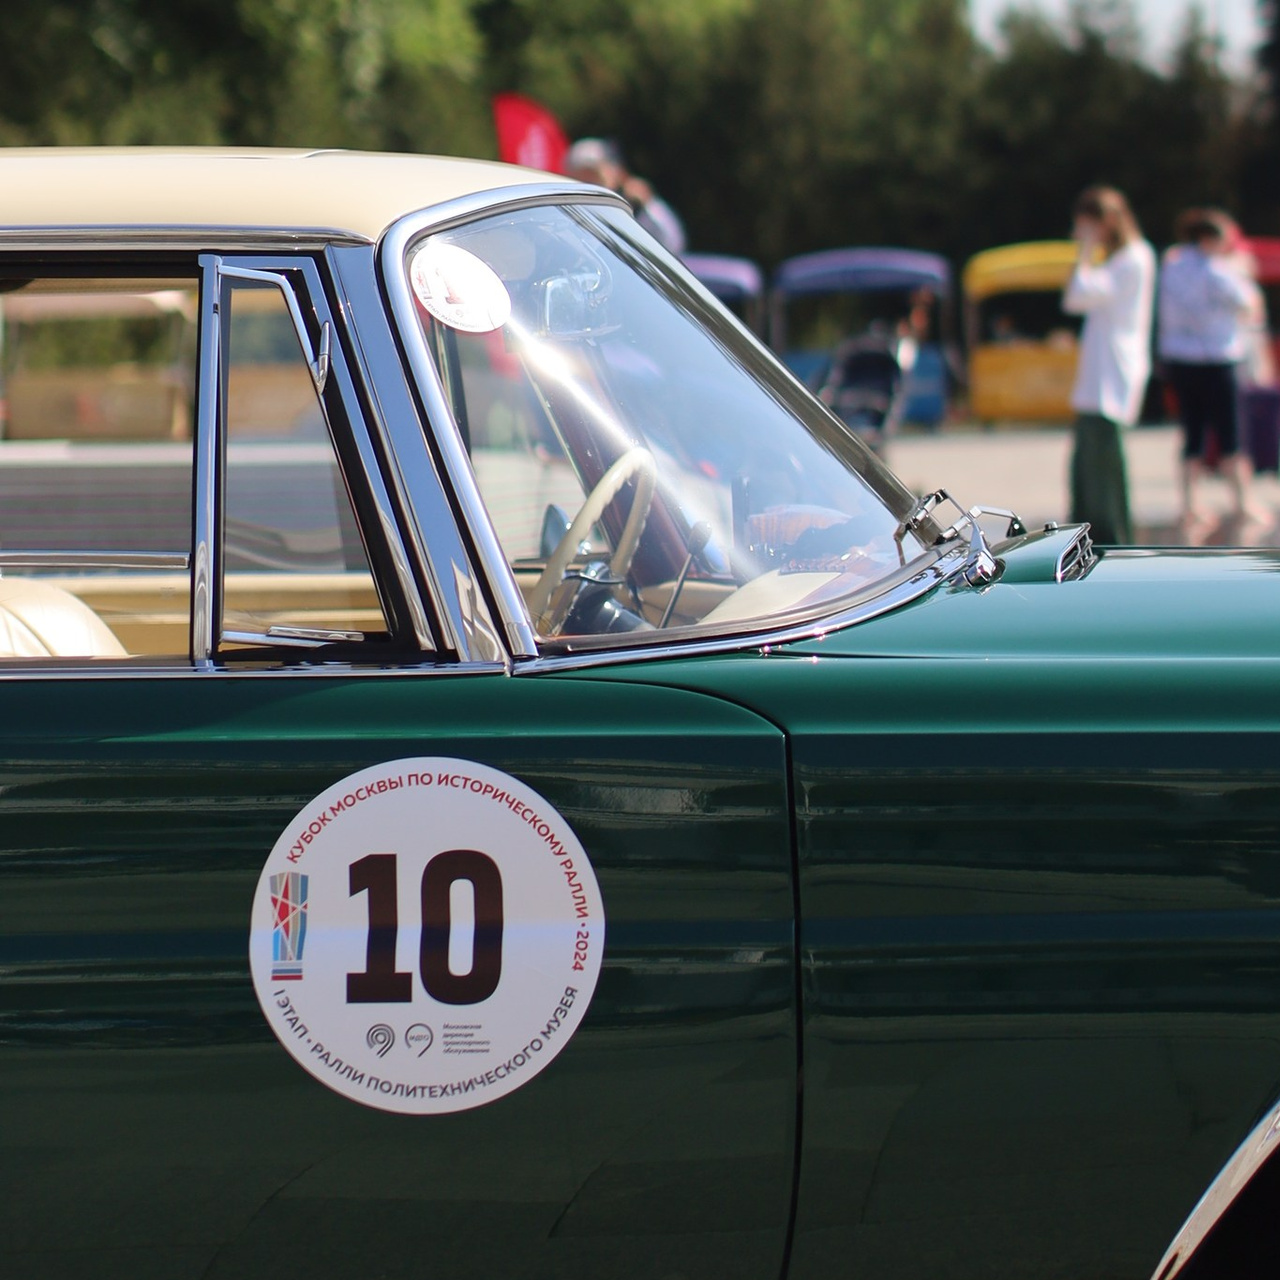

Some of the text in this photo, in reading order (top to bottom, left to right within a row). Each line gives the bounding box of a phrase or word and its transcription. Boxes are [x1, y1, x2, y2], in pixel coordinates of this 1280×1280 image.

[286, 773, 589, 972] КУБОК МОСКВЫ ПО ИСТОРИЧЕСКОМУ РАЛЛИ 2024
[346, 849, 503, 1005] 10
[277, 996, 309, 1039] ЭТАП
[310, 1042, 366, 1084] РАЛЛИ
[366, 1038, 543, 1098] ПОЛИТЕХНИЧЕСКОГО
[540, 986, 578, 1040] МУЗЕЯ
